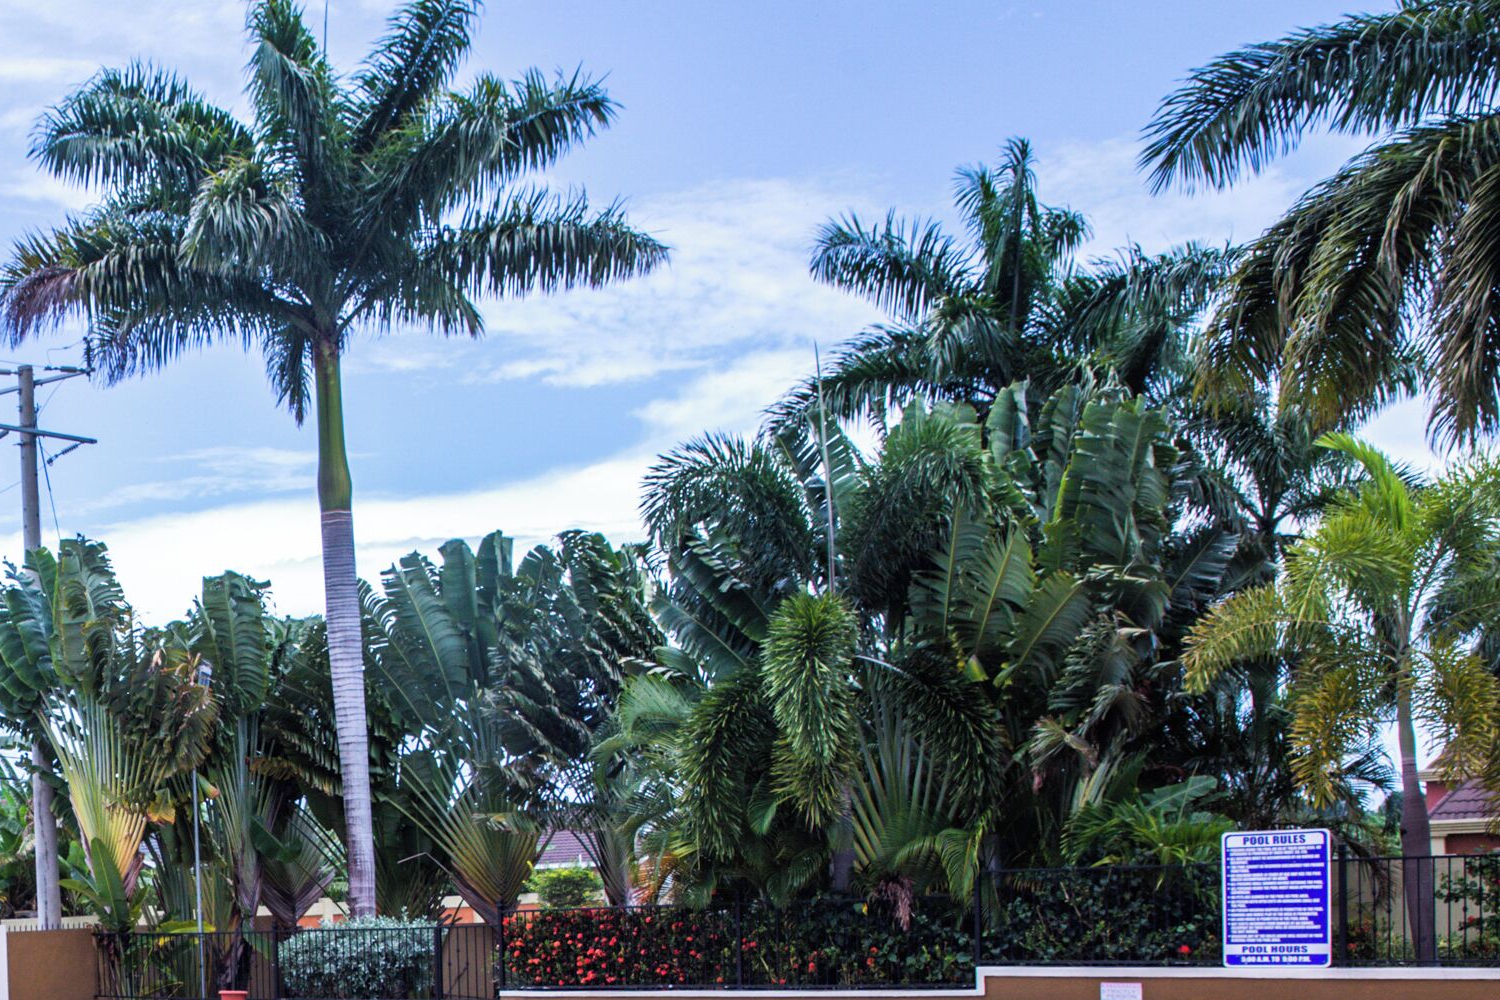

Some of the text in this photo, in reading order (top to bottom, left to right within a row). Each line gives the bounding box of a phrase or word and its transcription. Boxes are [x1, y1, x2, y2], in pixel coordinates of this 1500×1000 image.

[1243, 834, 1306, 845] POOL RULES
[1271, 945, 1308, 953] HOURS
